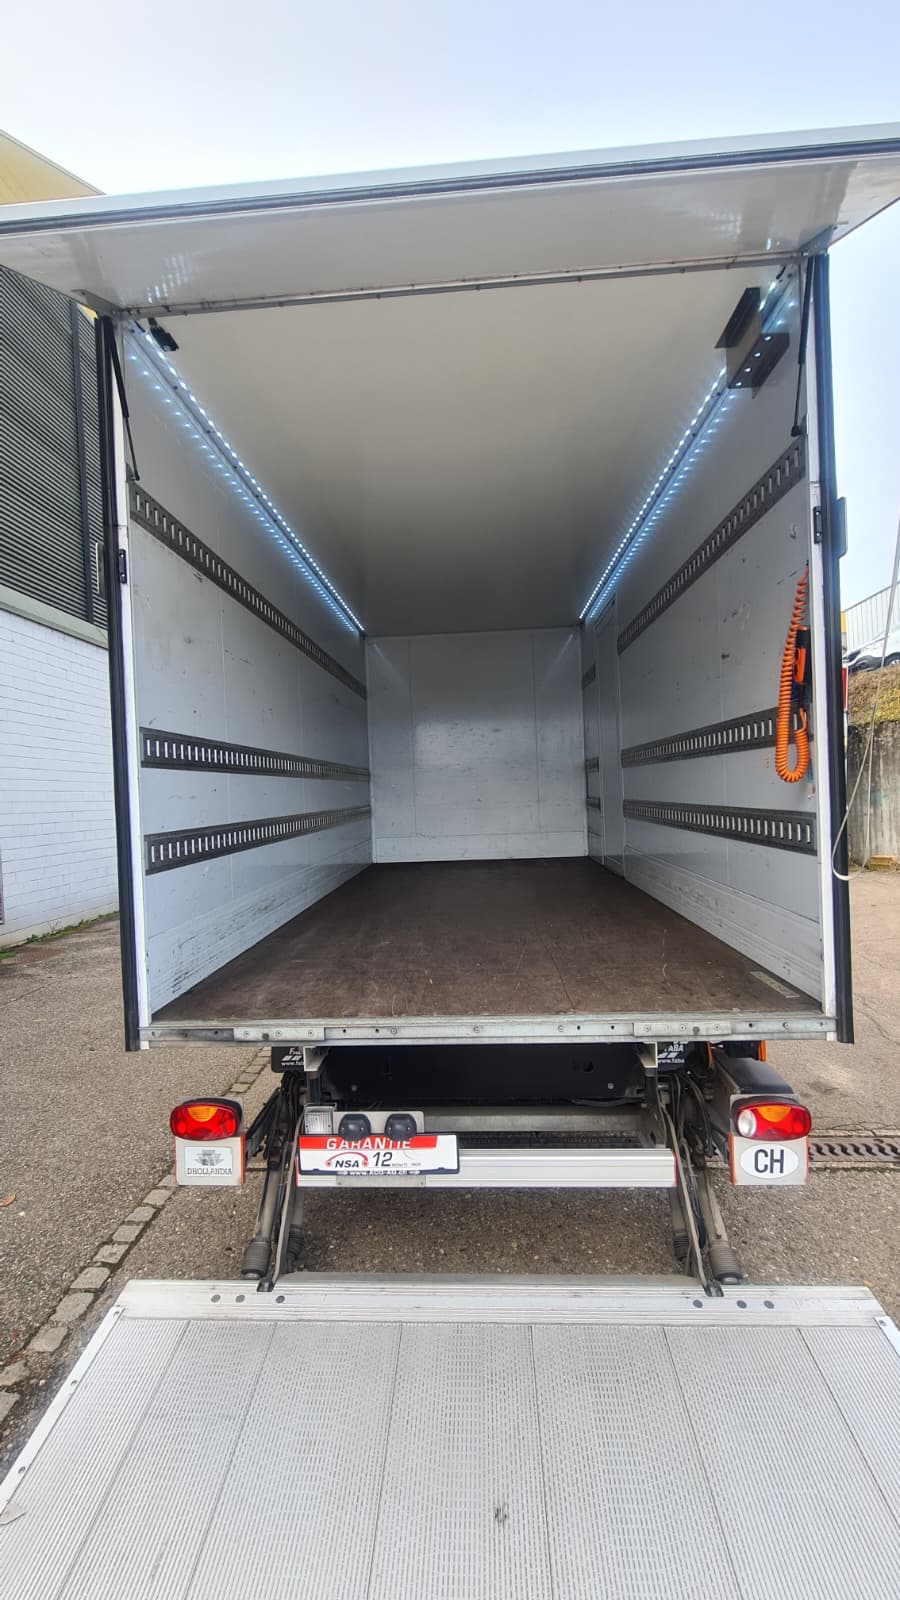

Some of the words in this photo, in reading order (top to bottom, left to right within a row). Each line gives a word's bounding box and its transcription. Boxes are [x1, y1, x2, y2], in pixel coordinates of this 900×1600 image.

[326, 1137, 411, 1149] GARANTIE
[334, 1159, 359, 1168] NSA
[372, 1151, 393, 1167] 12
[754, 1148, 785, 1174] CH
[187, 1167, 232, 1175] DHOLLANDIA
